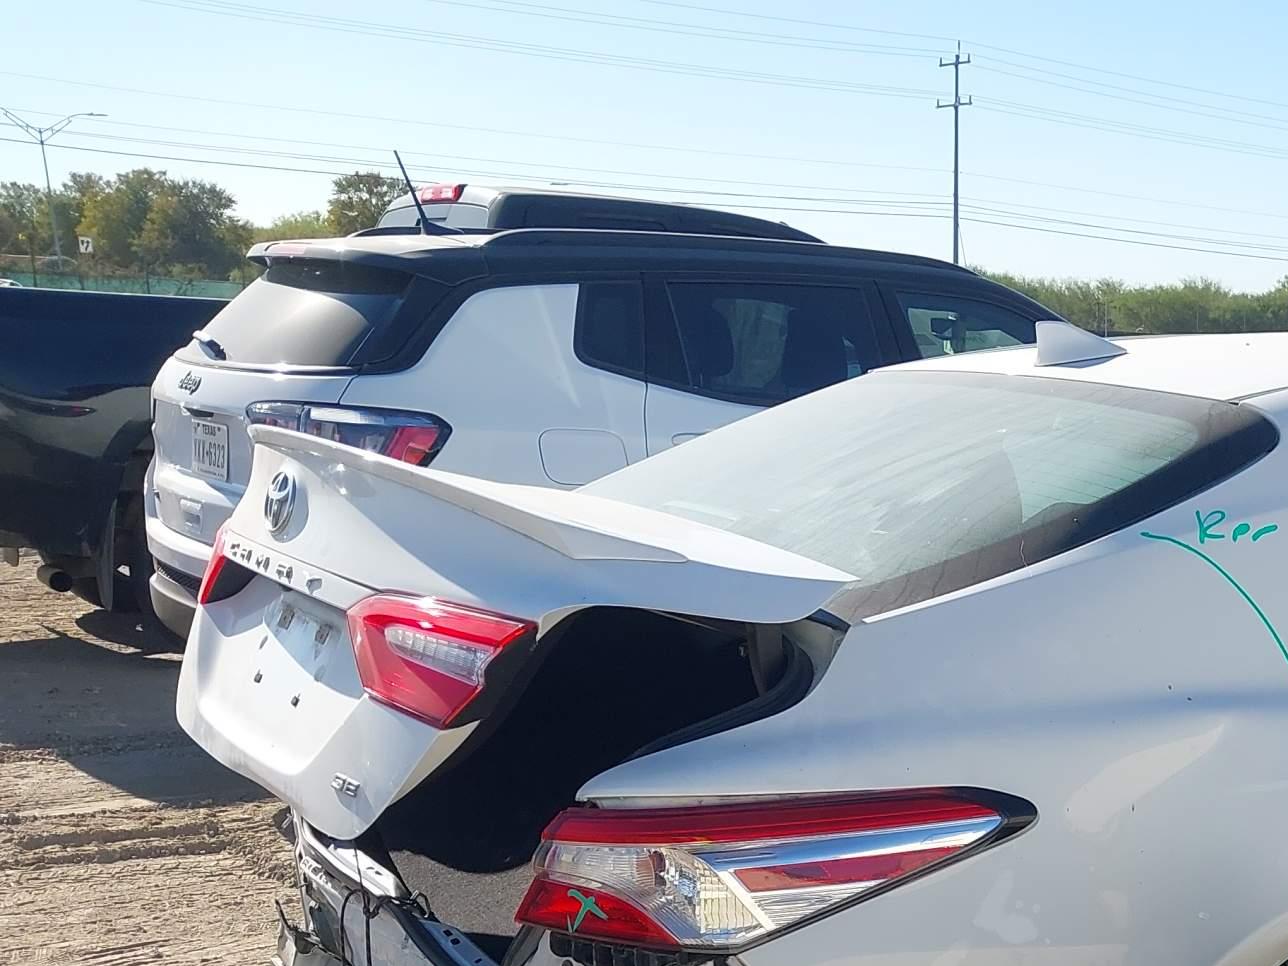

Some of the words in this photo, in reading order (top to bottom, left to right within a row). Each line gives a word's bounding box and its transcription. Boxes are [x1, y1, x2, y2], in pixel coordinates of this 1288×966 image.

[178, 370, 202, 395] Jeep
[202, 424, 217, 437] TEXAS
[330, 771, 361, 799] SE
